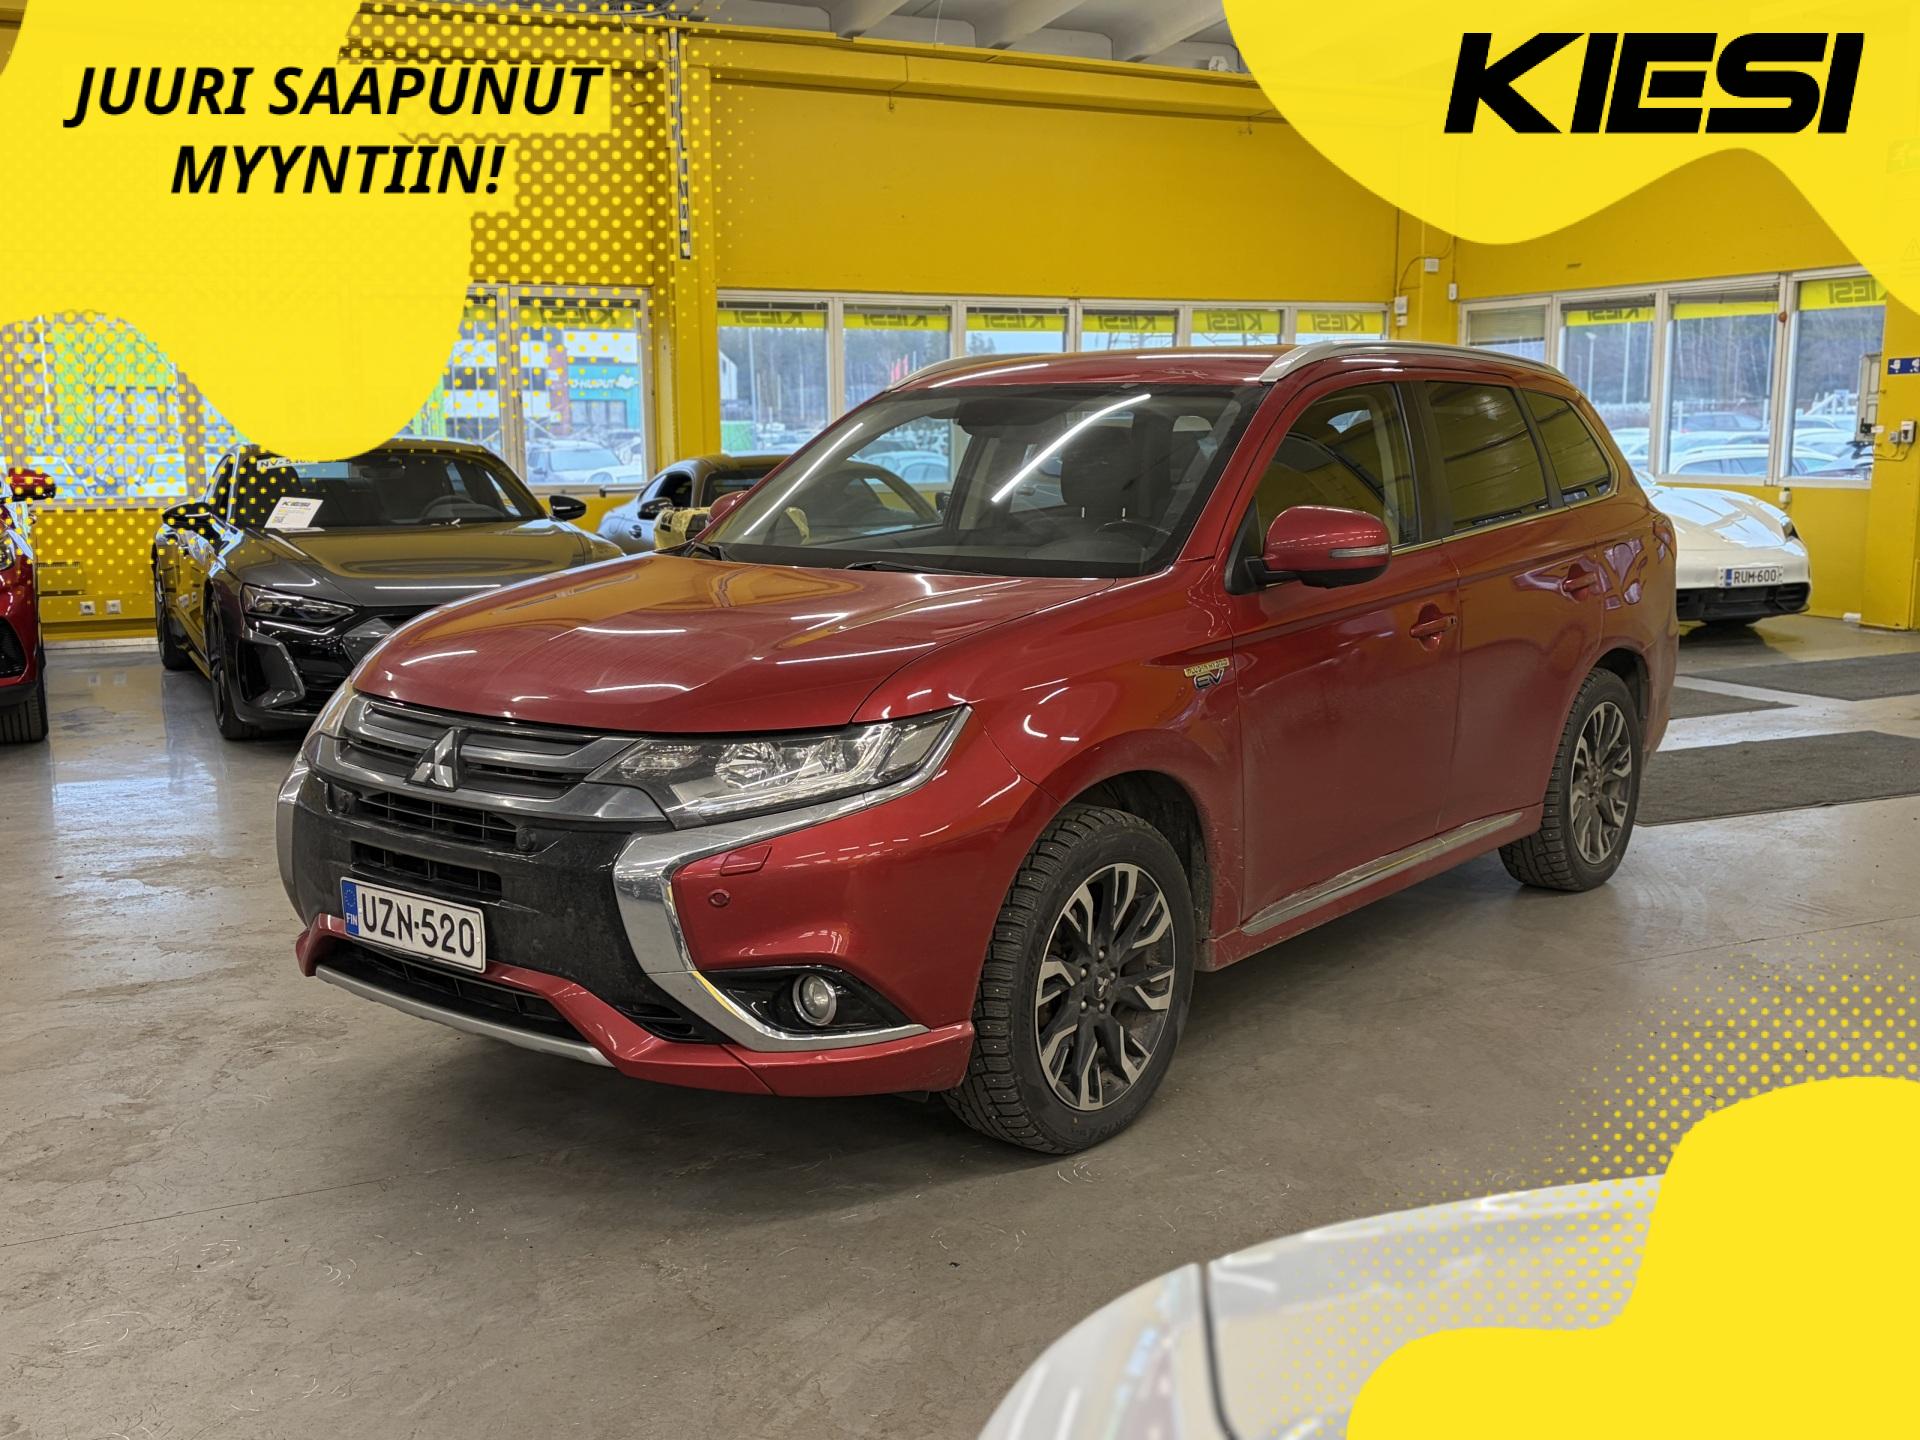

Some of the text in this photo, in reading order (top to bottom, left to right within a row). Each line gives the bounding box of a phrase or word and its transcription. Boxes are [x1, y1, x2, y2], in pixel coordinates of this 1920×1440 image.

[1733, 570, 1777, 584] RUM-600
[346, 893, 475, 958] FIN UZN-520
